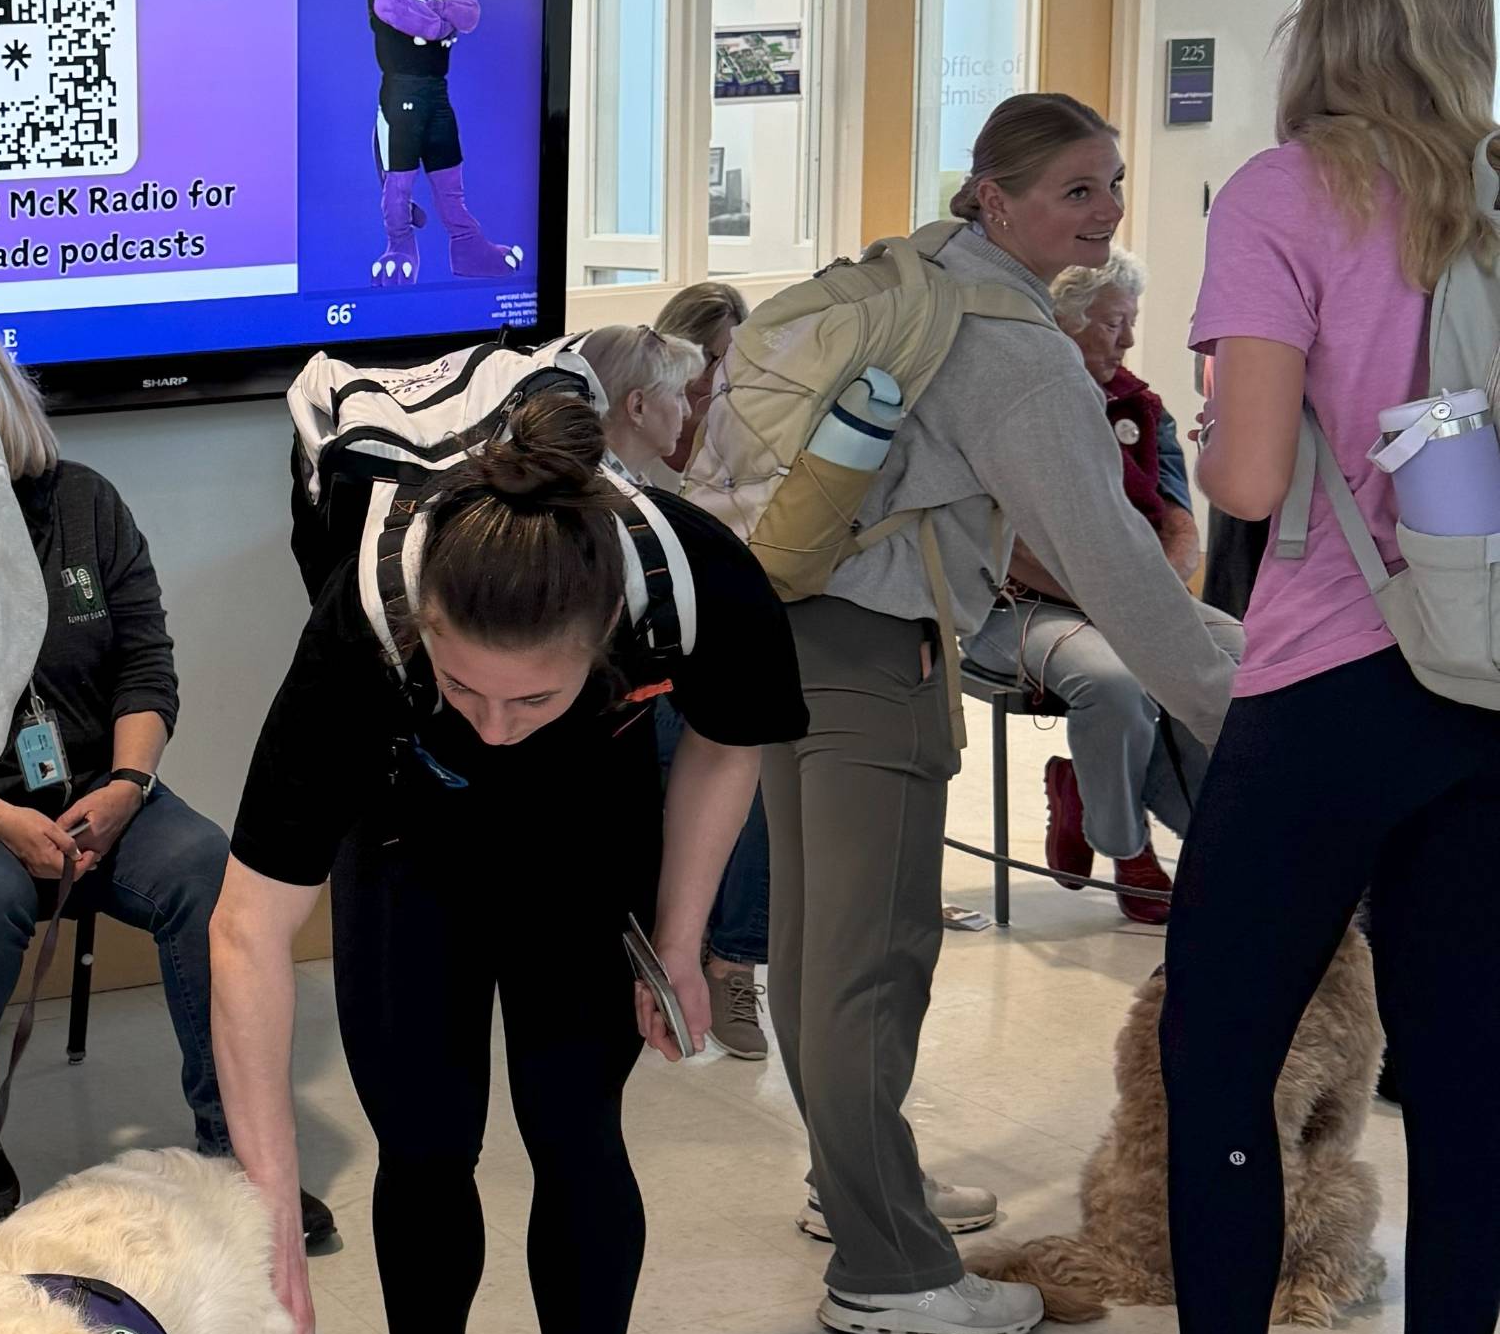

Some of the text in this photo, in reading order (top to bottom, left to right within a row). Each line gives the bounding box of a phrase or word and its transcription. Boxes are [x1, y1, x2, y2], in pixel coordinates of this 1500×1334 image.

[931, 52, 1024, 77] Office of
[1181, 44, 1206, 62] 225
[10, 190, 78, 218] McK
[89, 182, 178, 214] Radio
[188, 179, 236, 208] for
[60, 231, 205, 274] podcasts
[142, 376, 188, 388] SHARP
